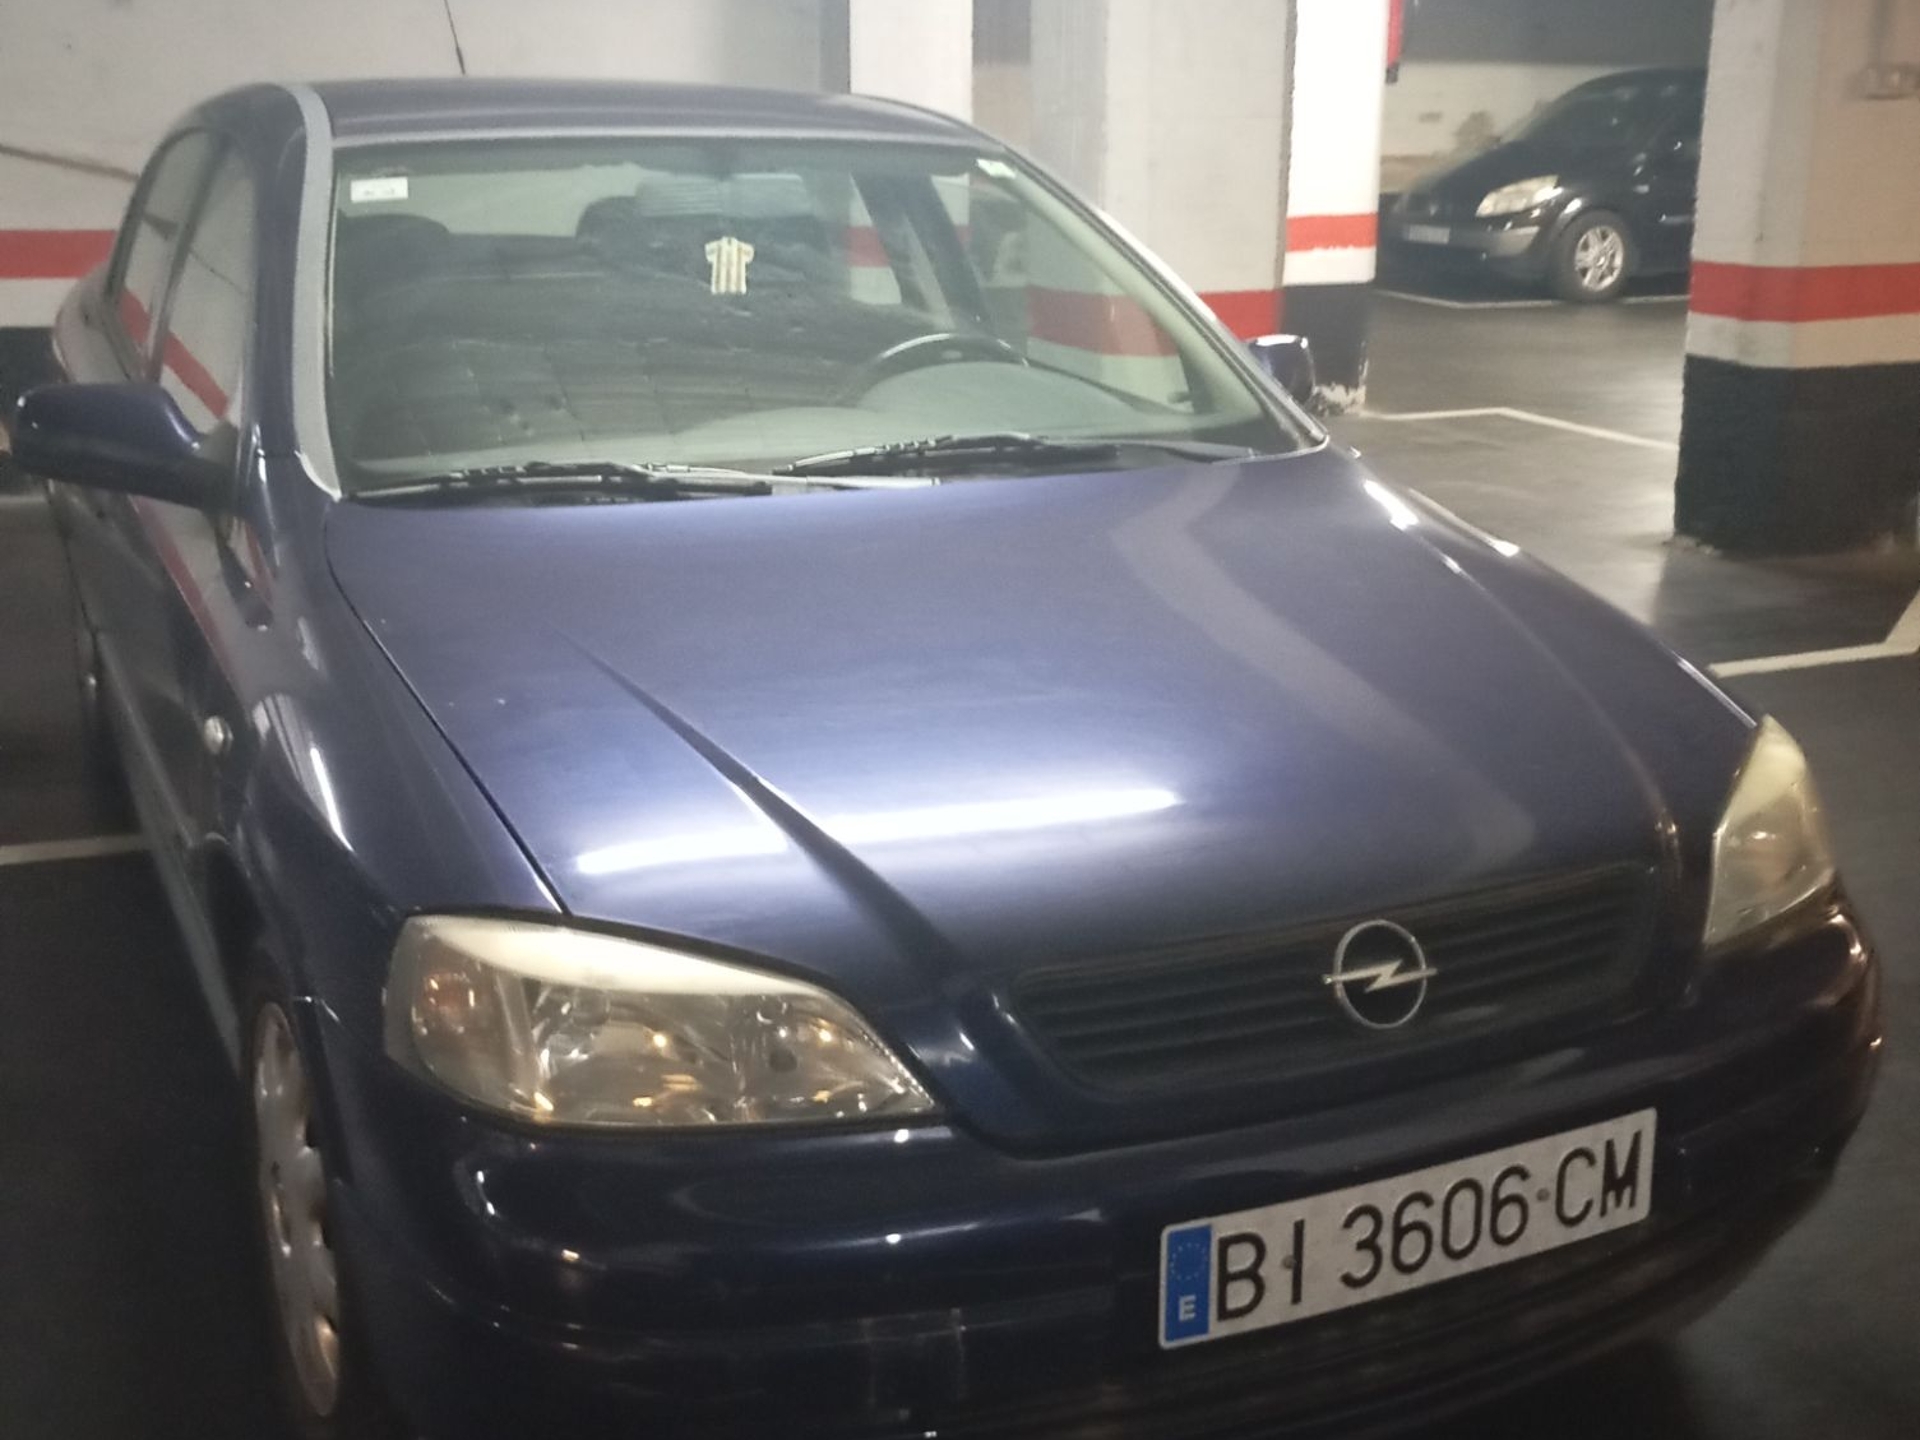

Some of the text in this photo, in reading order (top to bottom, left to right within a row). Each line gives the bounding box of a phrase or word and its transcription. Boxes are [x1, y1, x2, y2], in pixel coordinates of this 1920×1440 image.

[1339, 1164, 1531, 1290] 3606
[1554, 1129, 1643, 1228] CM
[1178, 1294, 1196, 1322] E
